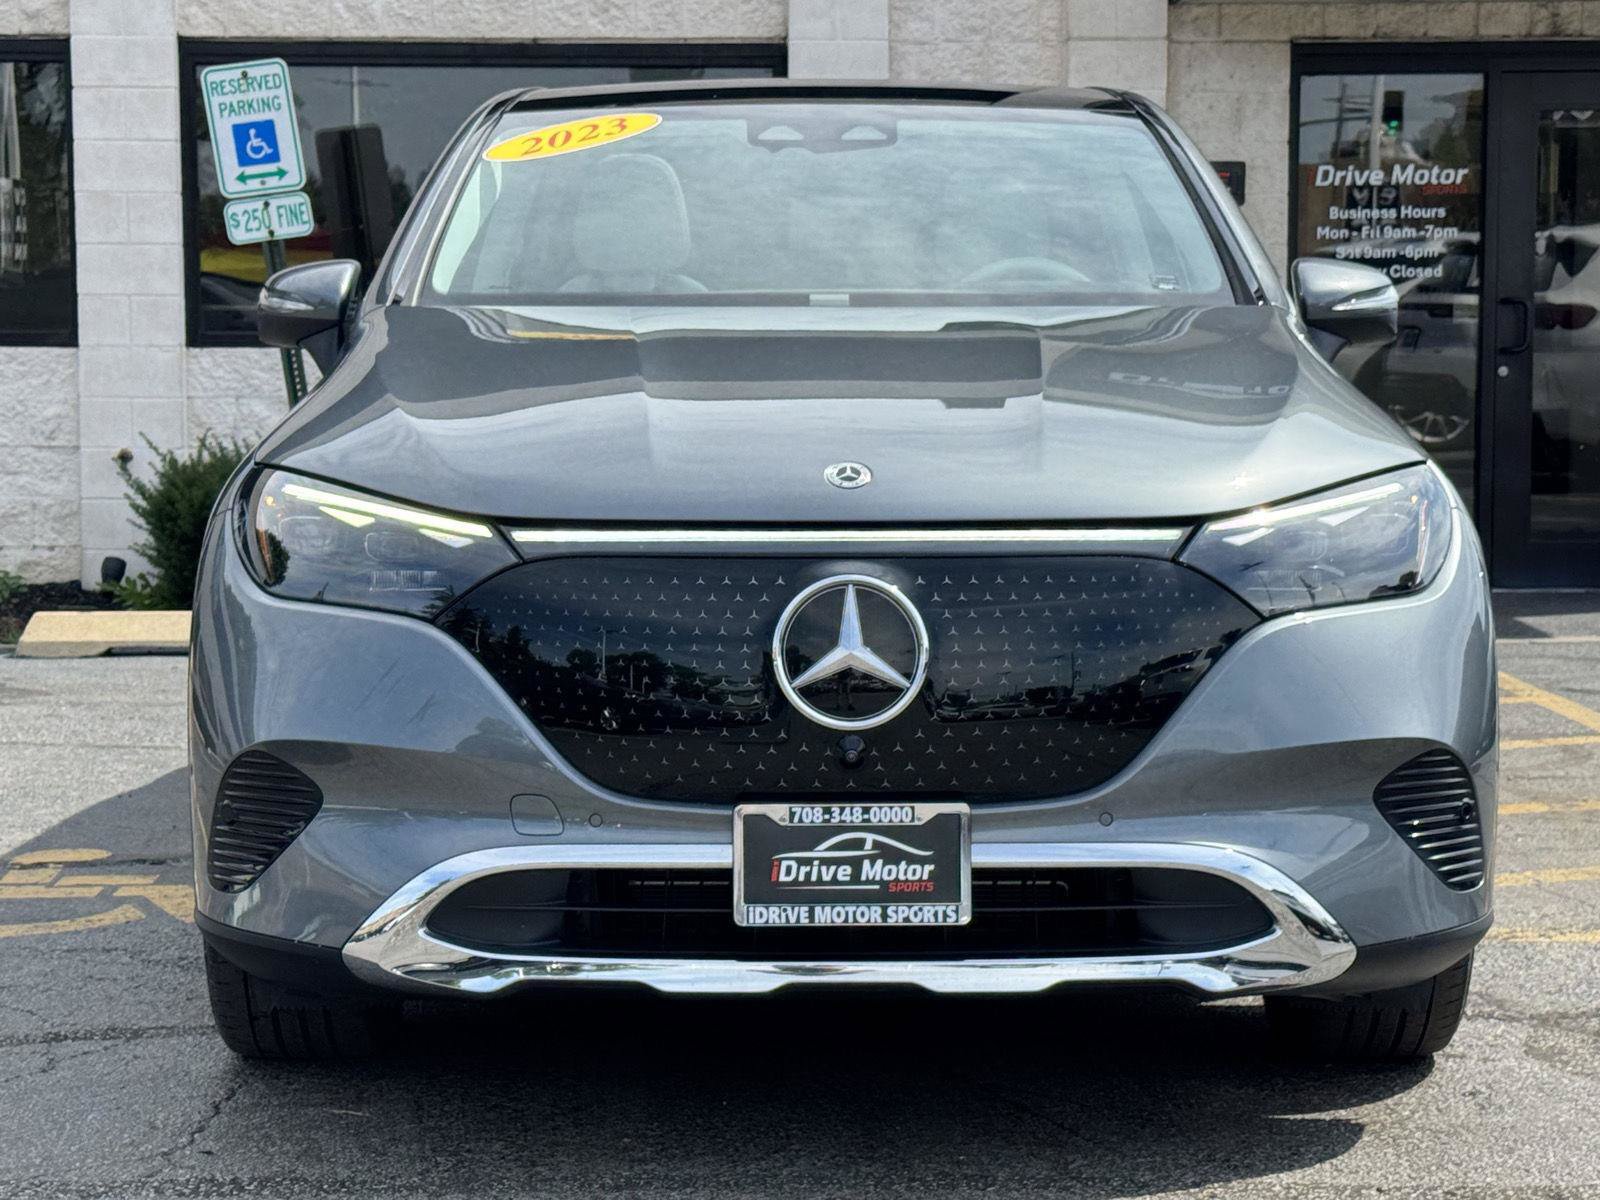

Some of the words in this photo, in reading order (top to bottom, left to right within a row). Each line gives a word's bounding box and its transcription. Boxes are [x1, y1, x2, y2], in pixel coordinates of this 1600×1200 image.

[210, 73, 282, 97] RESERVED
[218, 96, 282, 118] PARKING
[521, 118, 628, 157] 2023
[1391, 163, 1469, 186] Motor
[229, 208, 271, 233] $250
[276, 202, 310, 228] FINE
[1328, 206, 1397, 220] Business
[1400, 205, 1446, 219] Hours
[1316, 226, 1350, 240] Mon
[1361, 225, 1380, 239] Fri
[1389, 264, 1443, 279] Closed
[790, 806, 912, 824] 708-348-0000
[770, 859, 852, 883] iDrive
[860, 859, 935, 882] Motor
[888, 881, 935, 893] SPORTS
[814, 906, 883, 925] MOTOR
[886, 906, 958, 925] SPORTS
